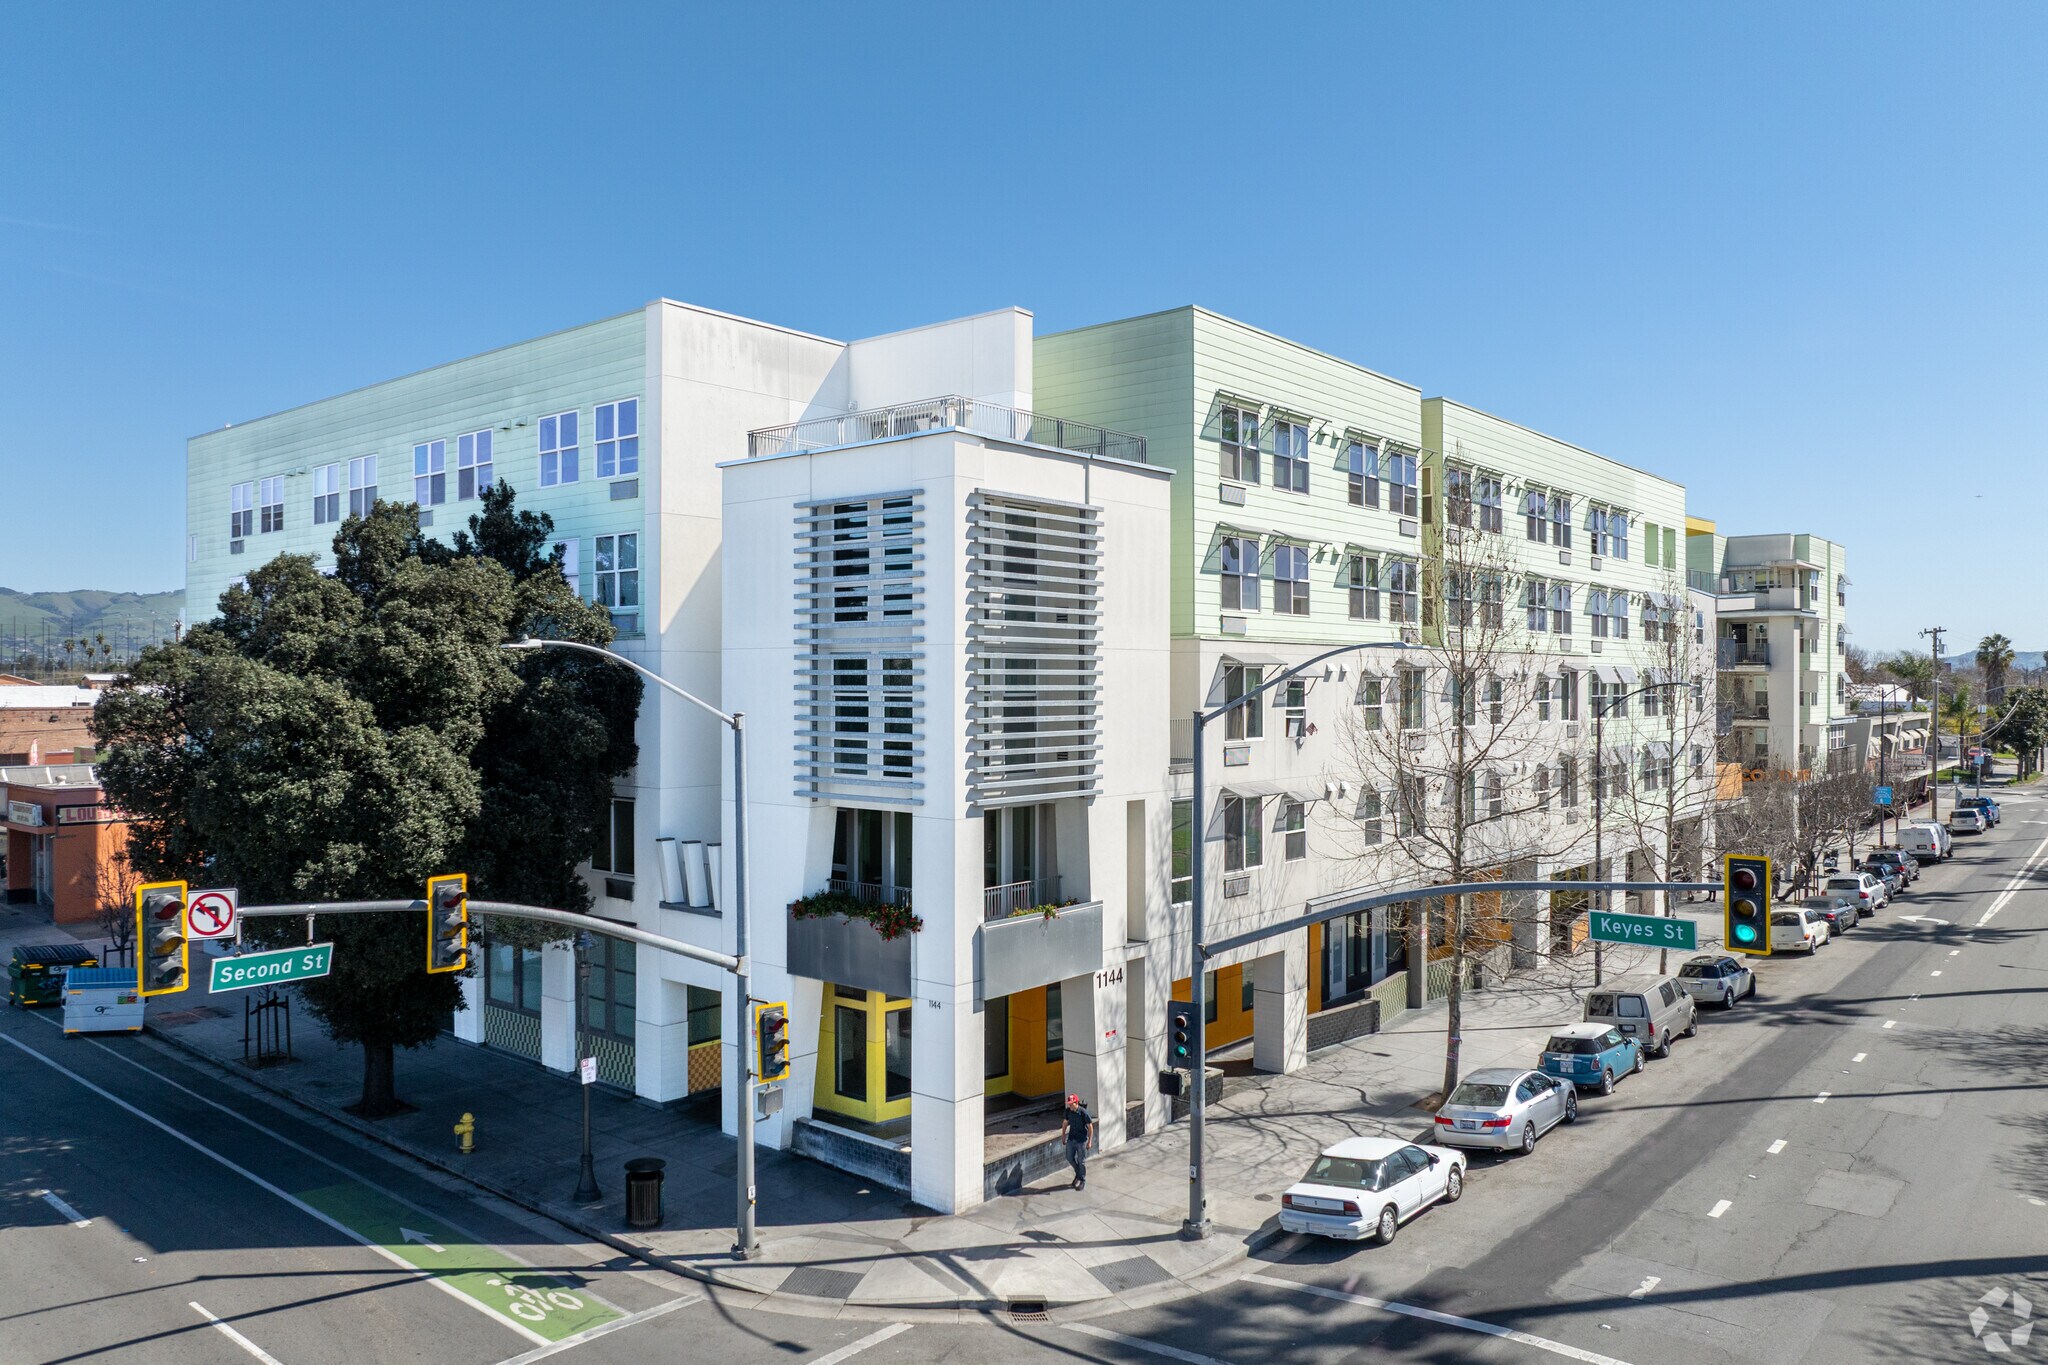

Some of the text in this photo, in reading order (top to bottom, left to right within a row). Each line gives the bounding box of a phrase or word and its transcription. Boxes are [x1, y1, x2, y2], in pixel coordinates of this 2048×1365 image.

[1600, 917, 1684, 940] Keyes St
[220, 954, 324, 983] Second St
[1096, 967, 1123, 989] 1144
[928, 999, 941, 1010] 1144
